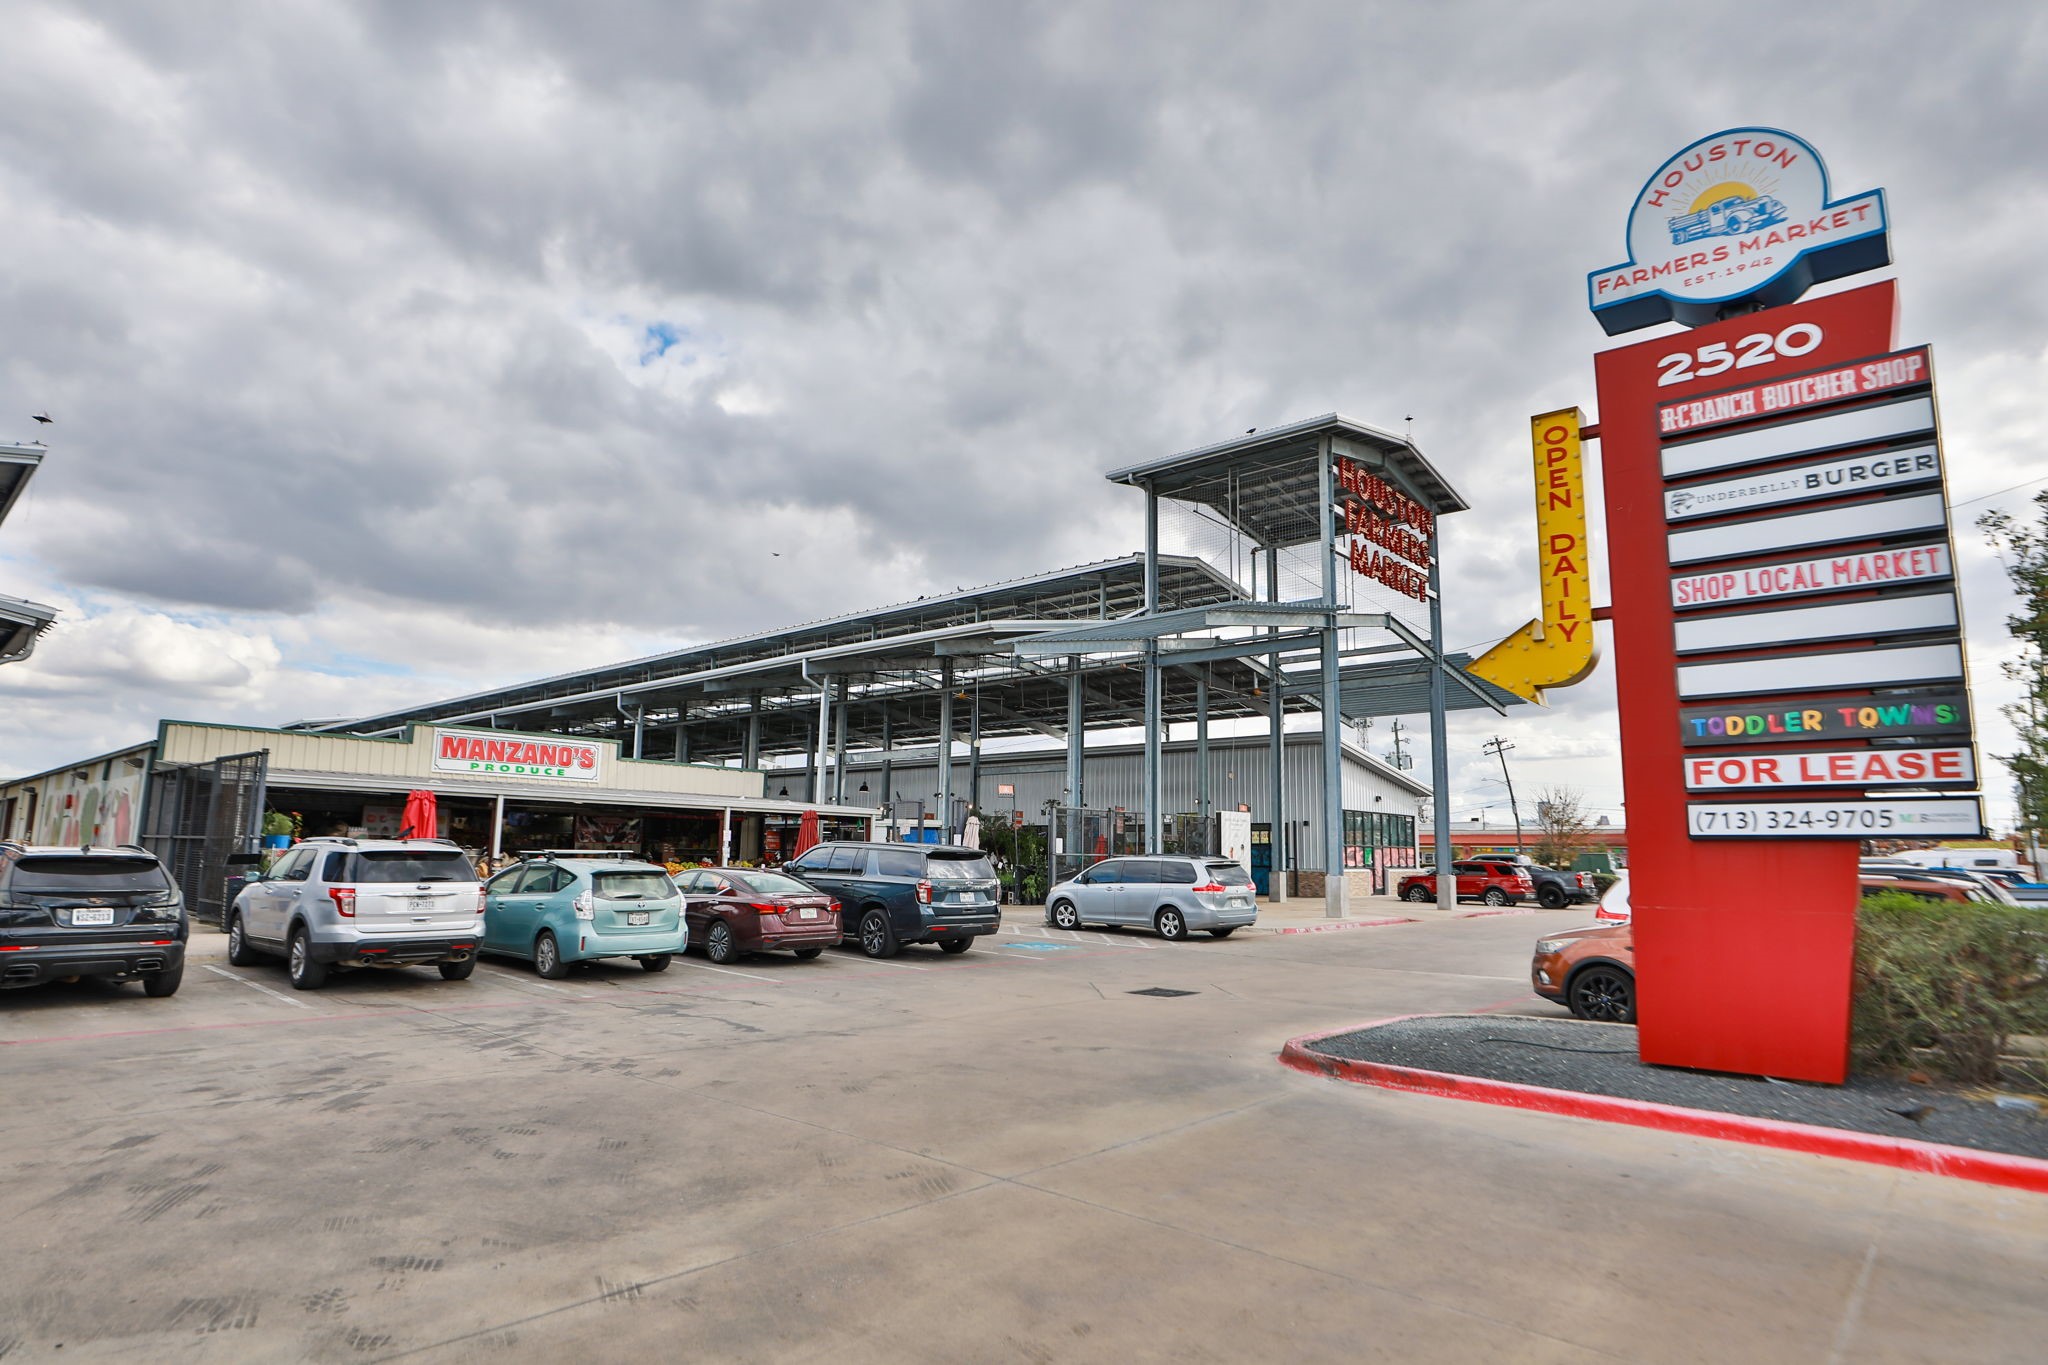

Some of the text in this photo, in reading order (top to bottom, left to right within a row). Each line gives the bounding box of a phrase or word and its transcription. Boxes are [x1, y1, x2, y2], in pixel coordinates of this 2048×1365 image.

[1648, 140, 1798, 207] HOUSTON
[1598, 204, 1871, 294] FARMERS MARKET
[1657, 323, 1823, 387] 2520
[1762, 369, 1858, 403] BUTCHER
[1862, 355, 1922, 389] SHOP
[1339, 456, 1433, 539] HOUSTON
[1697, 454, 1935, 504] UNDERBELLY BURGER
[1345, 499, 1430, 569] FARMERS
[1543, 425, 1580, 642] OPEN DAILY
[1351, 539, 1428, 603] MARKET
[1677, 547, 1942, 604] SHOP LOCAL MARKET
[1690, 703, 1961, 737] TODDLER TOWNS
[440, 735, 595, 769] MANZANO'S
[470, 762, 565, 777] PRODUCE
[1693, 751, 1963, 785] FOR LEASE
[1696, 810, 1758, 832] (713)
[1767, 809, 1894, 830] 324-9705
